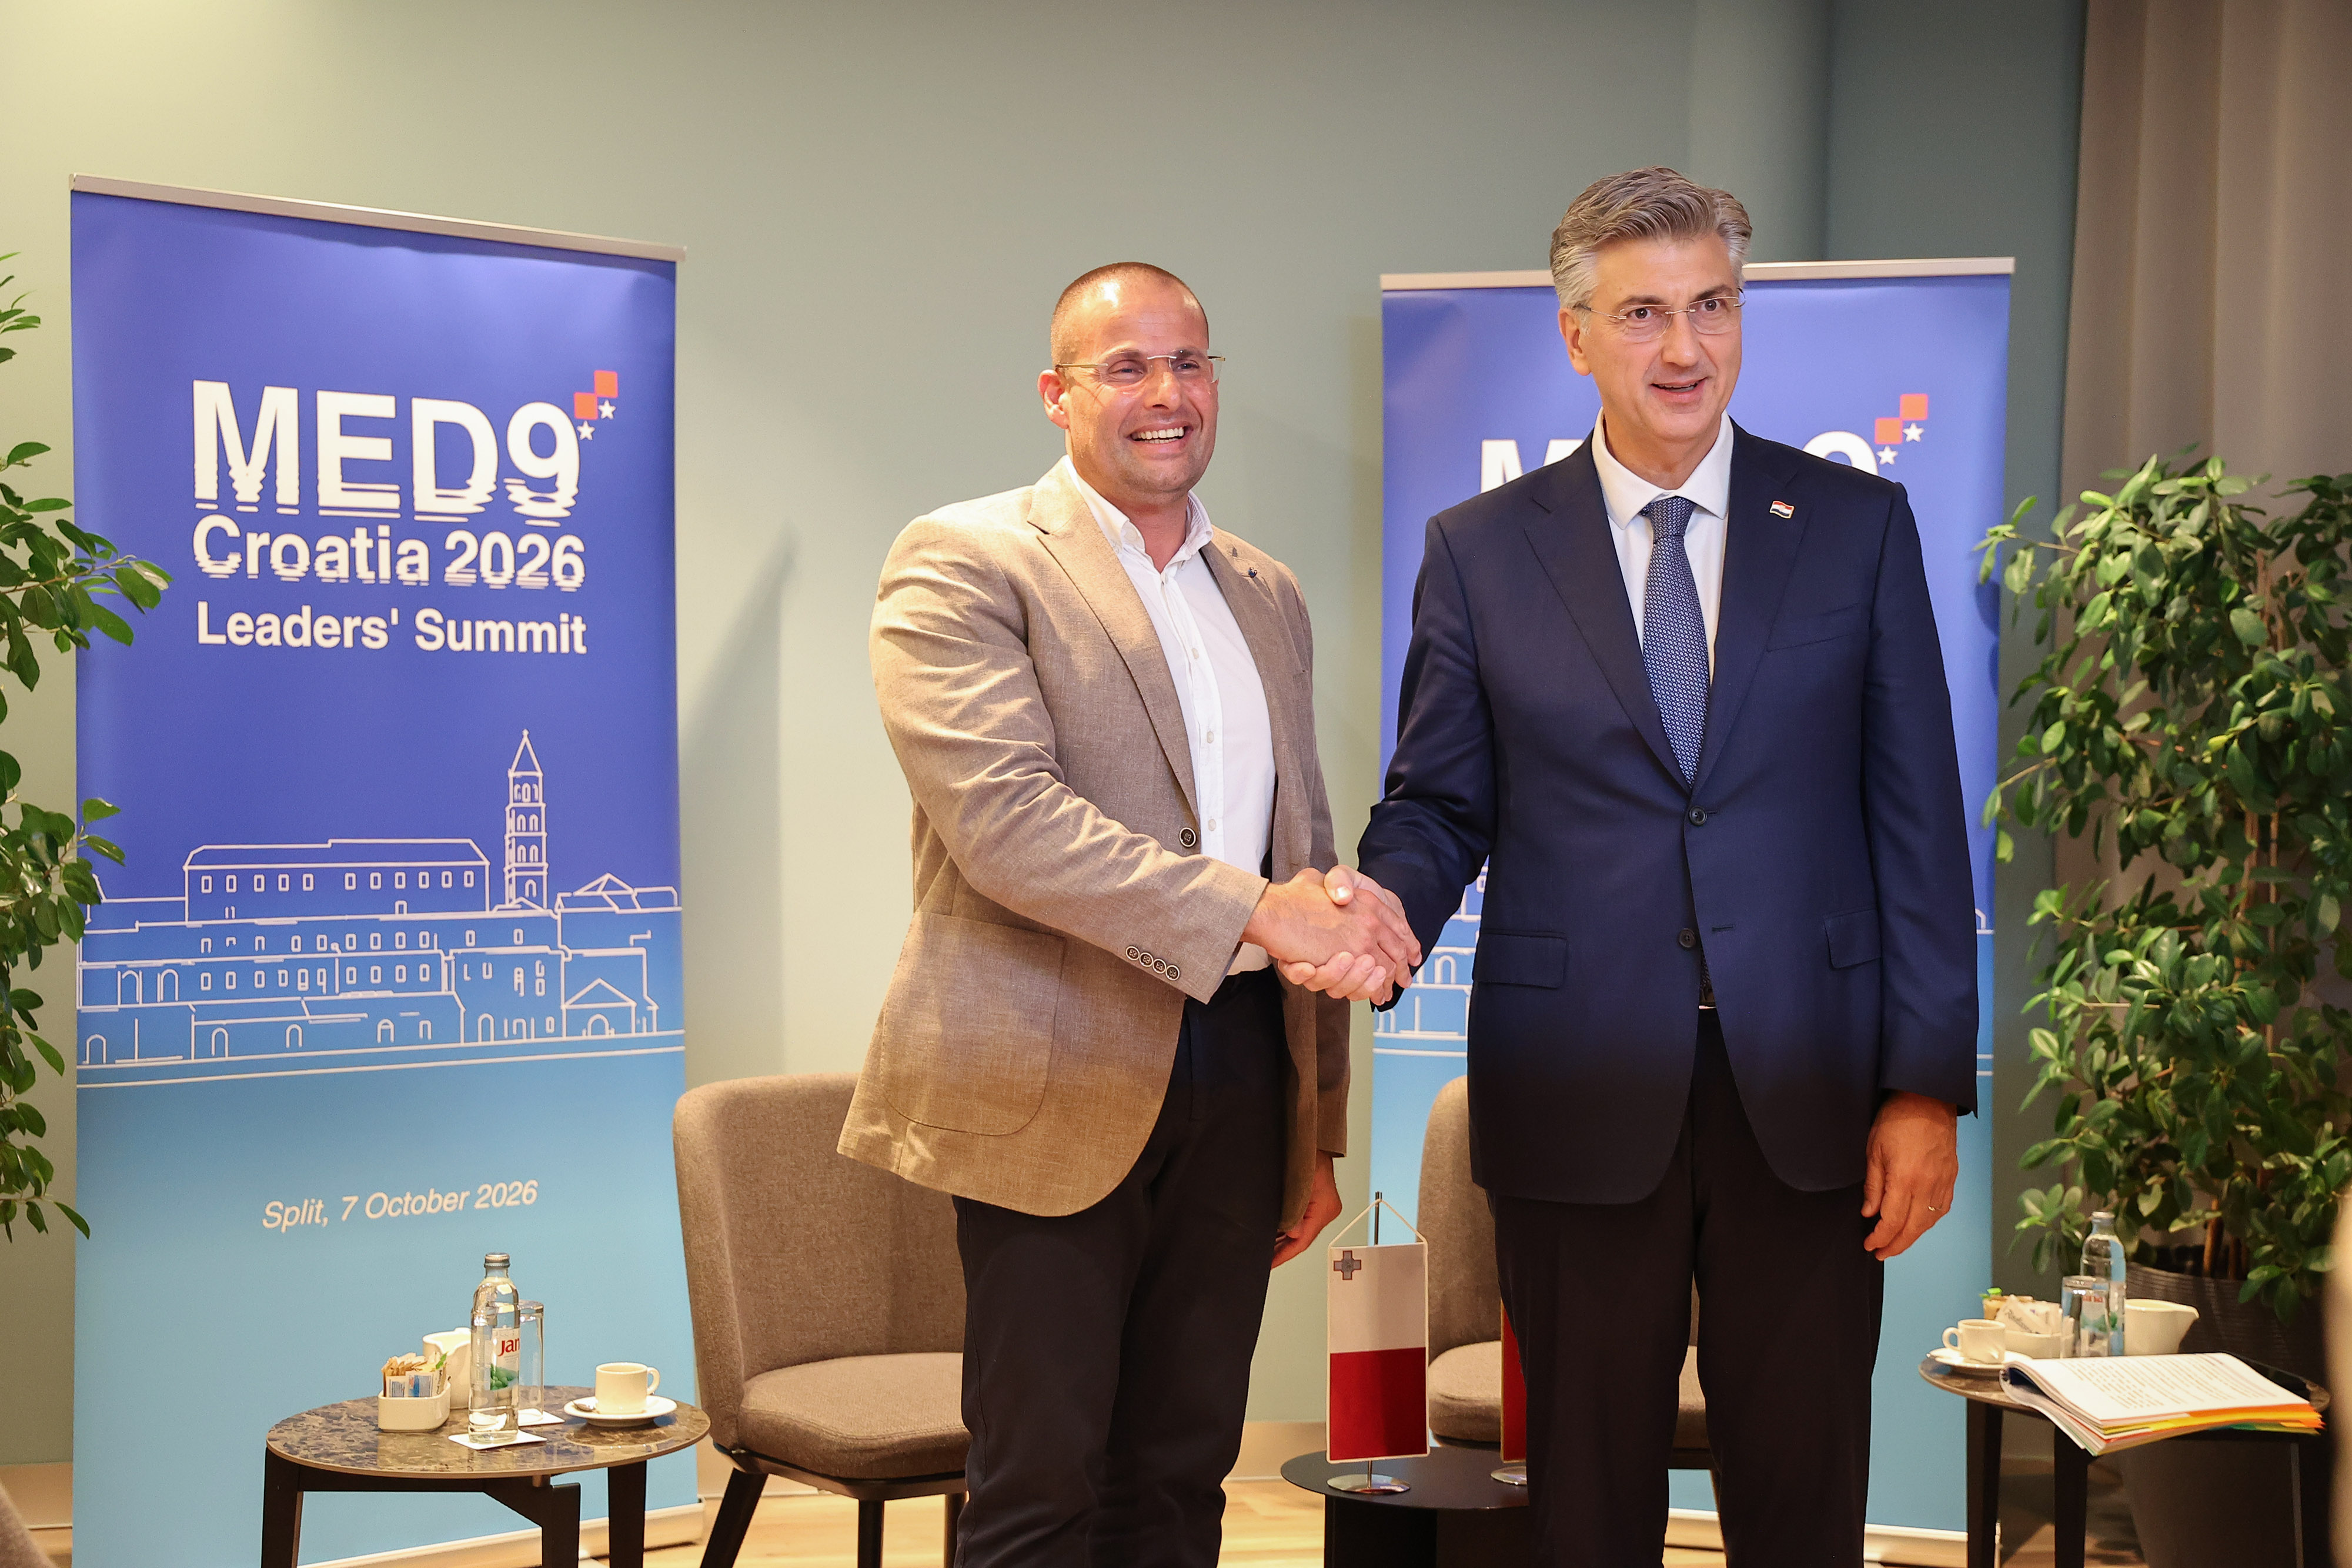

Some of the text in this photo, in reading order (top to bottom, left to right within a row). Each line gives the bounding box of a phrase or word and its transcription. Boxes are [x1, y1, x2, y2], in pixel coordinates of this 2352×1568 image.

[192, 379, 580, 527] MED9
[193, 514, 586, 592] Croatia 2026
[198, 601, 587, 654] Leaders' Summit
[262, 1179, 539, 1233] Split, 7 October 2026
